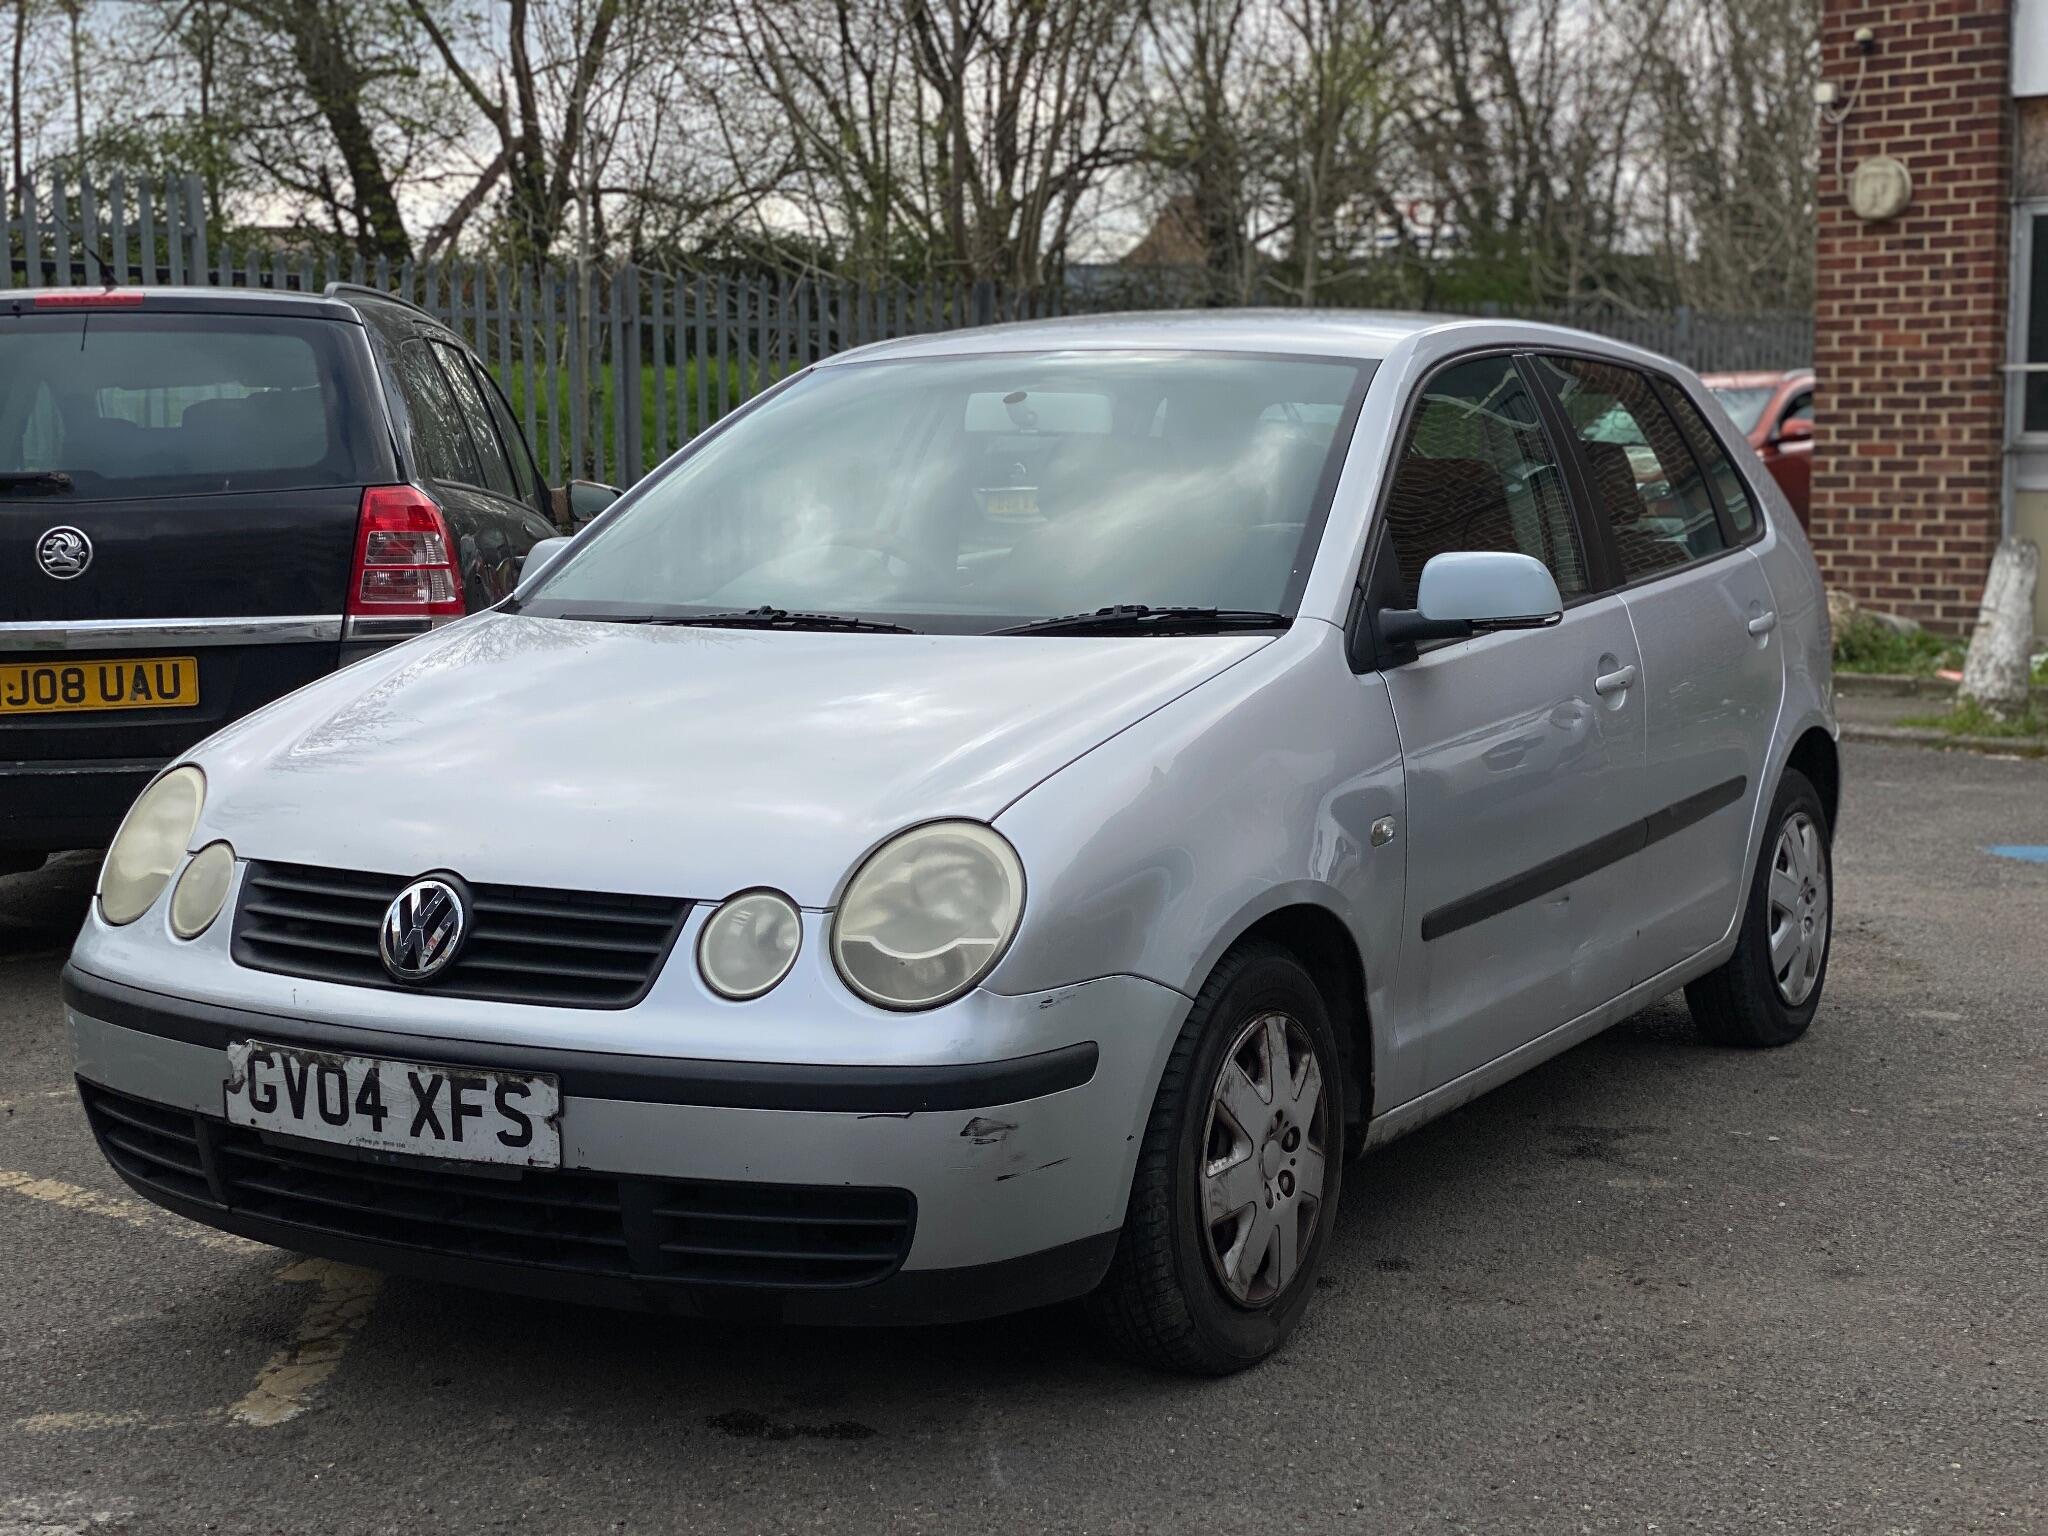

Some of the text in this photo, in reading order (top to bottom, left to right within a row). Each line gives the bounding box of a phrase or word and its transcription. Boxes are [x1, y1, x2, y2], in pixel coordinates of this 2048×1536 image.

[0, 664, 181, 705] J08 UAU
[247, 1050, 533, 1147] GV04 XFS
